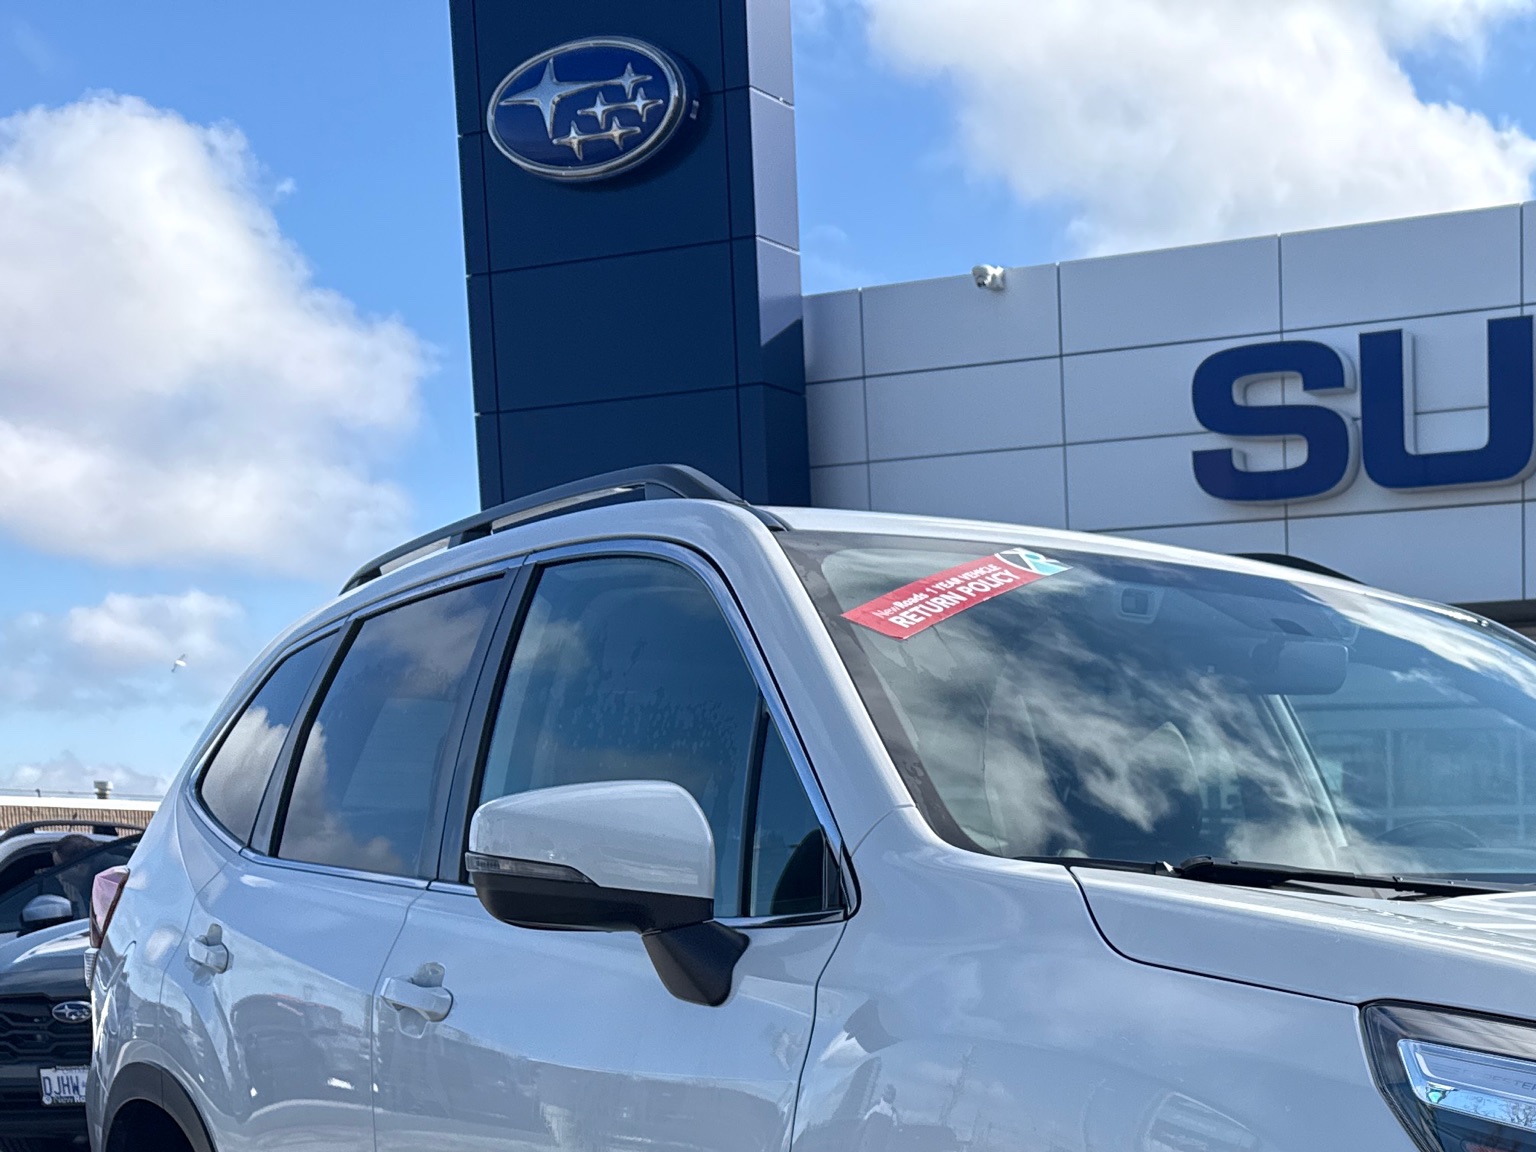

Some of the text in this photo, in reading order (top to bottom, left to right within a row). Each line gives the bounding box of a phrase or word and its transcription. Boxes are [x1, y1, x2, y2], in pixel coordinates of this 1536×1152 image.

[888, 569, 1021, 628] RETURN POLICY
[931, 576, 965, 591] YEAR
[957, 563, 1002, 581] VEHICLE
